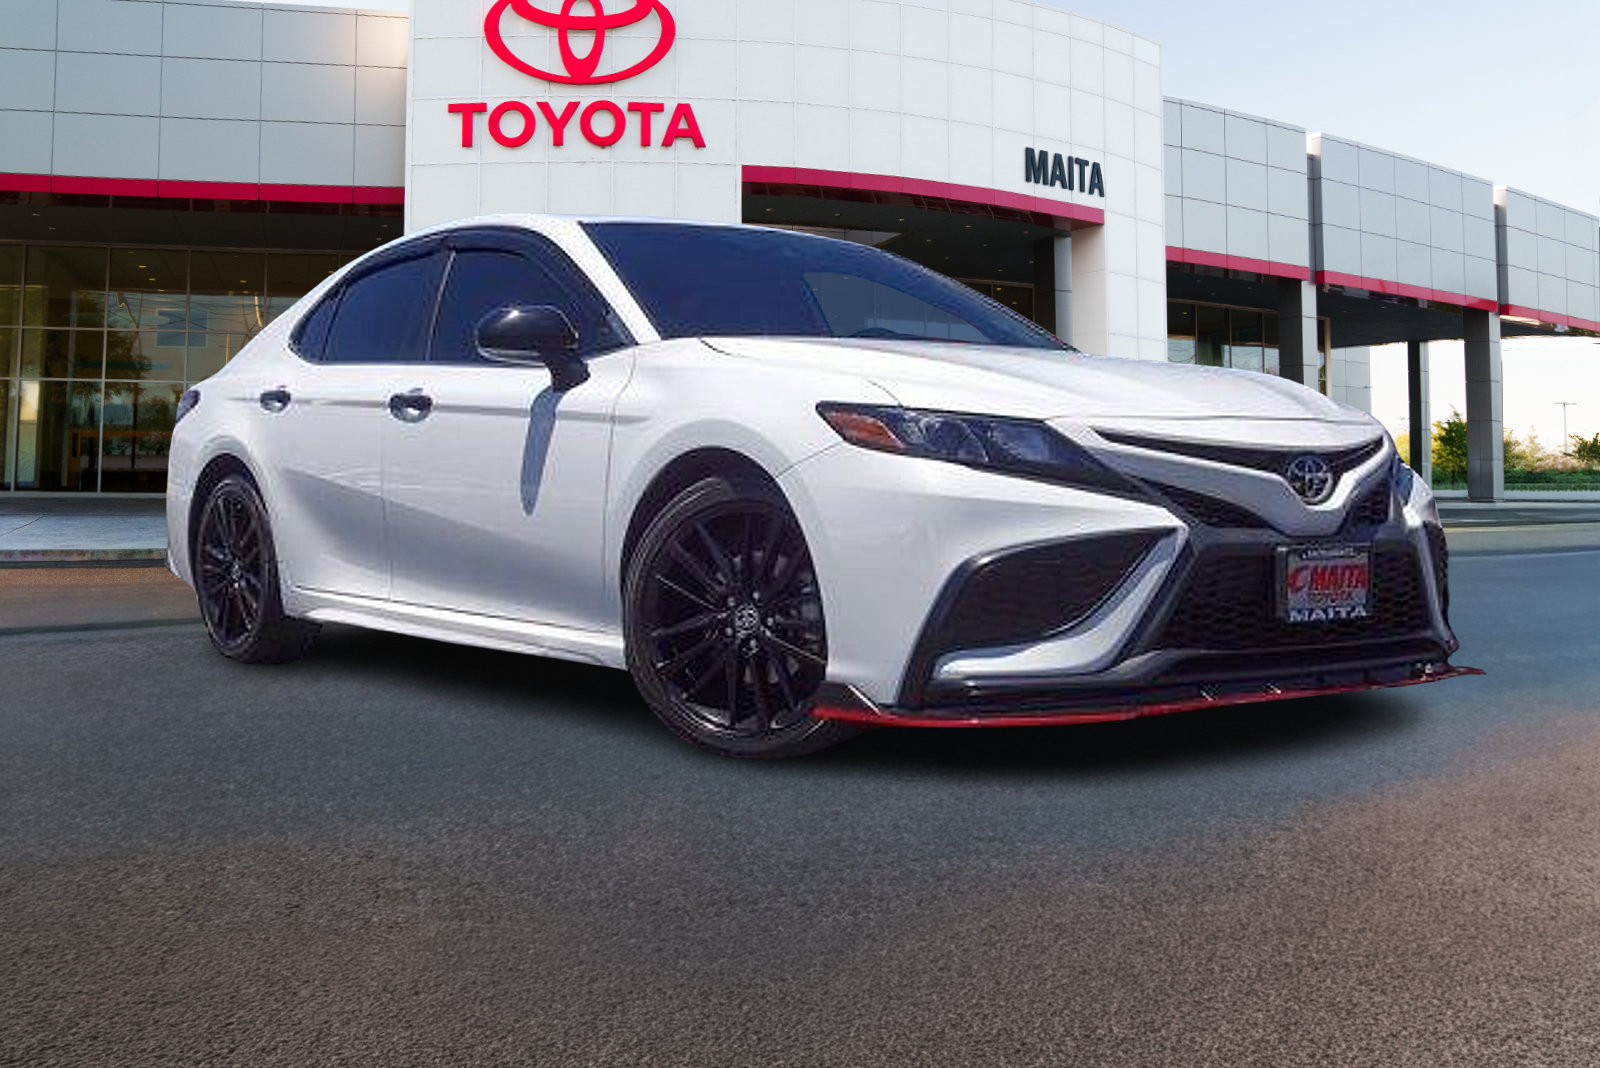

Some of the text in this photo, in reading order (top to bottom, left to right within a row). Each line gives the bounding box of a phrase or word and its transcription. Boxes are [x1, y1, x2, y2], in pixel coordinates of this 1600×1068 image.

[448, 100, 706, 148] TOYOTA
[1025, 147, 1105, 197] MAITA
[1289, 605, 1367, 622] MAITA
